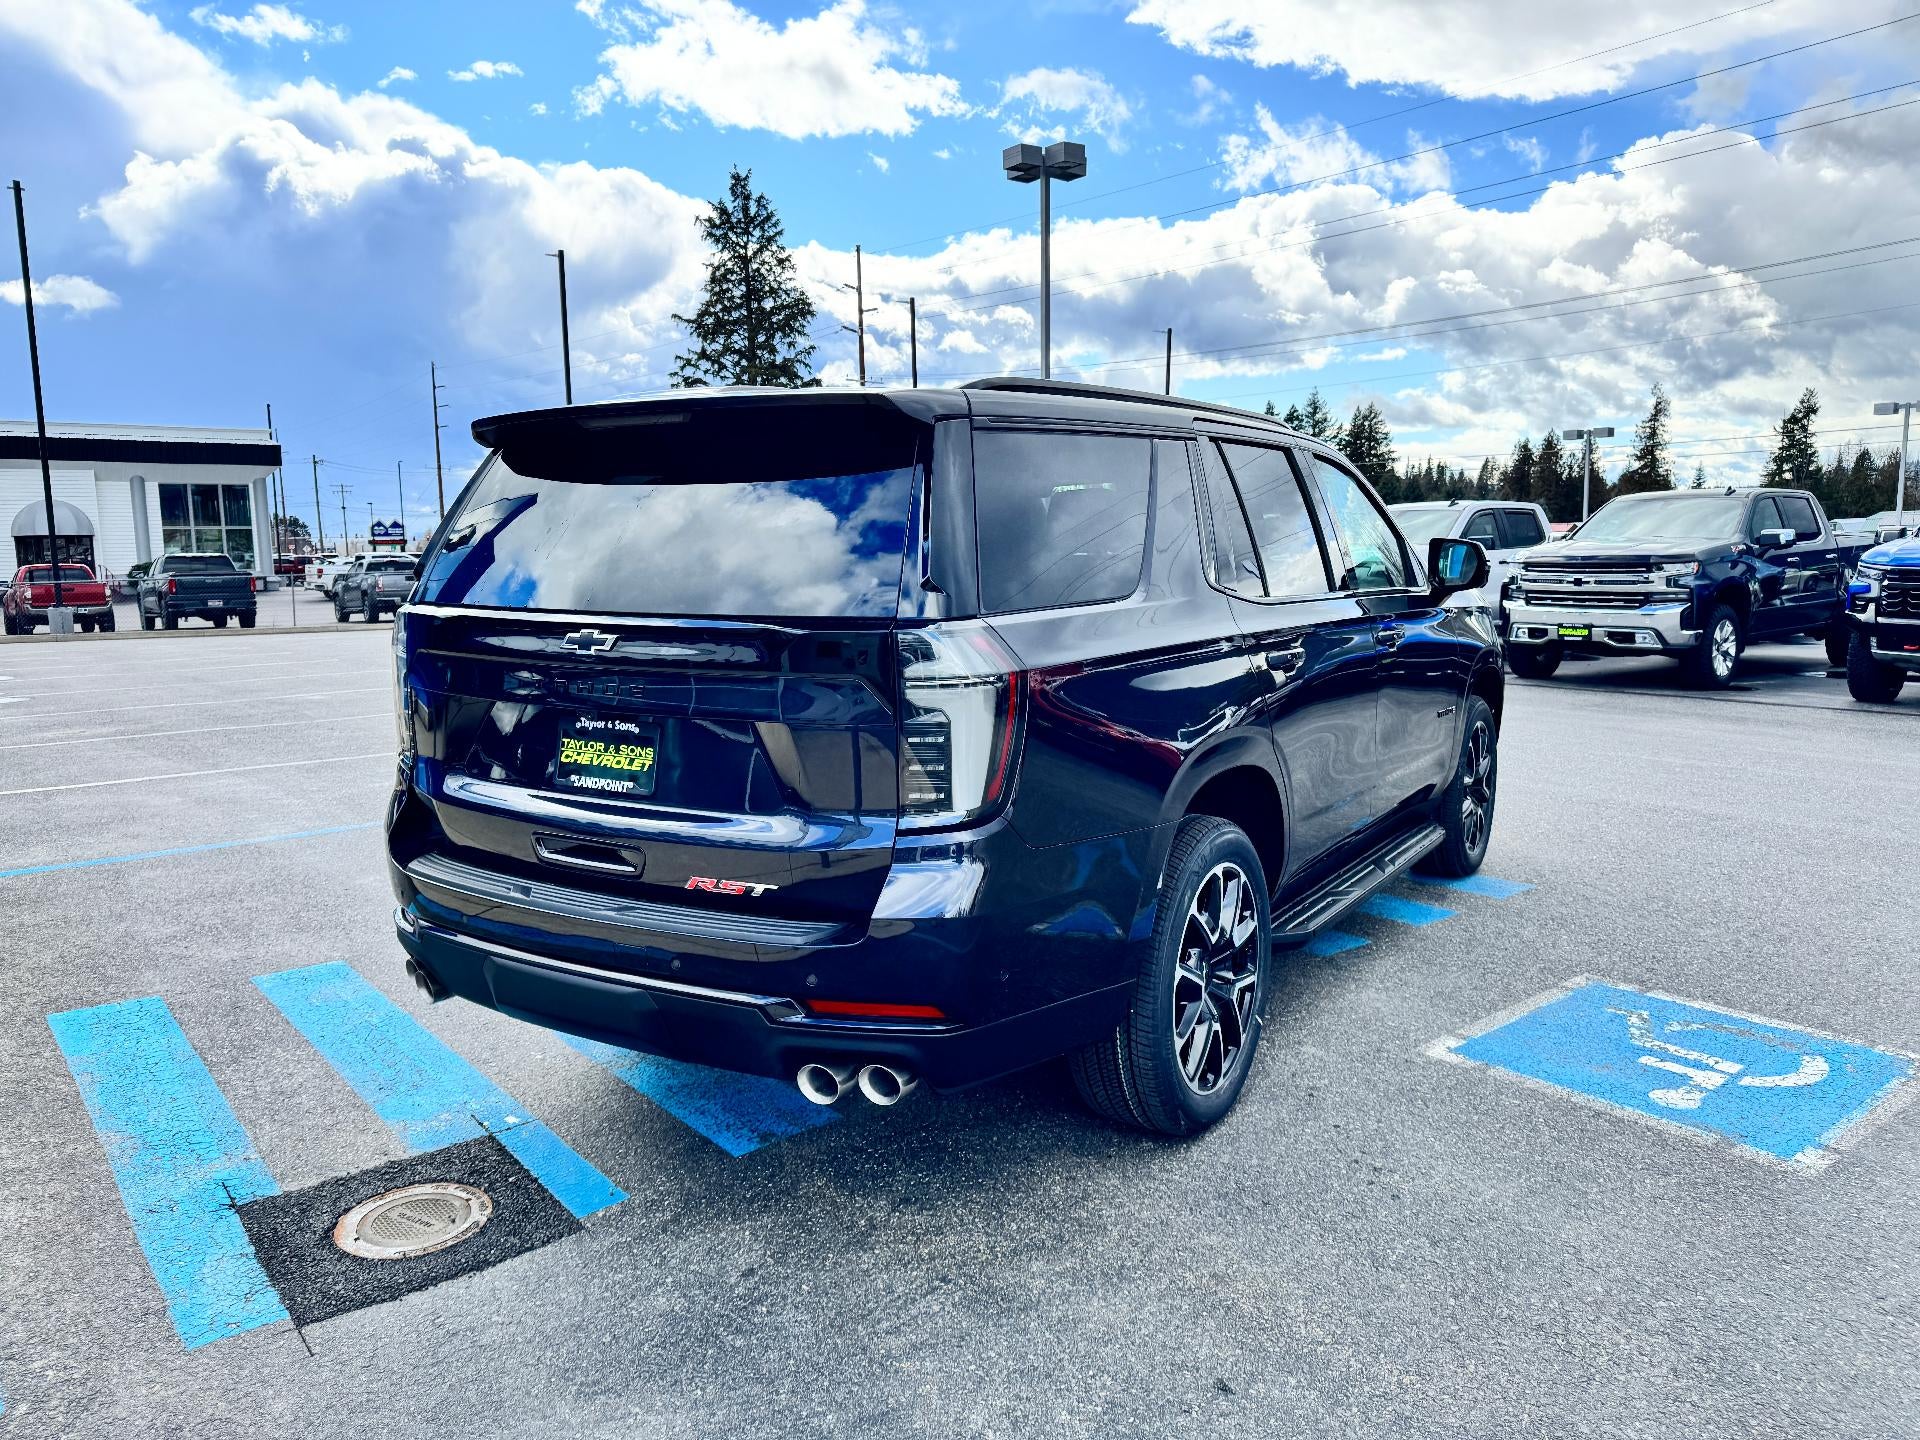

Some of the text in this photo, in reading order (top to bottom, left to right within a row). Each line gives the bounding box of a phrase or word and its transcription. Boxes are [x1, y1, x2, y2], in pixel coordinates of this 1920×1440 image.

[580, 717, 635, 731] Taylor & Sons
[562, 738, 654, 758] TAYLOR & SONS
[561, 751, 653, 772] CHEVROLET
[573, 775, 630, 793] SANDPOINT
[685, 876, 780, 896] RST
